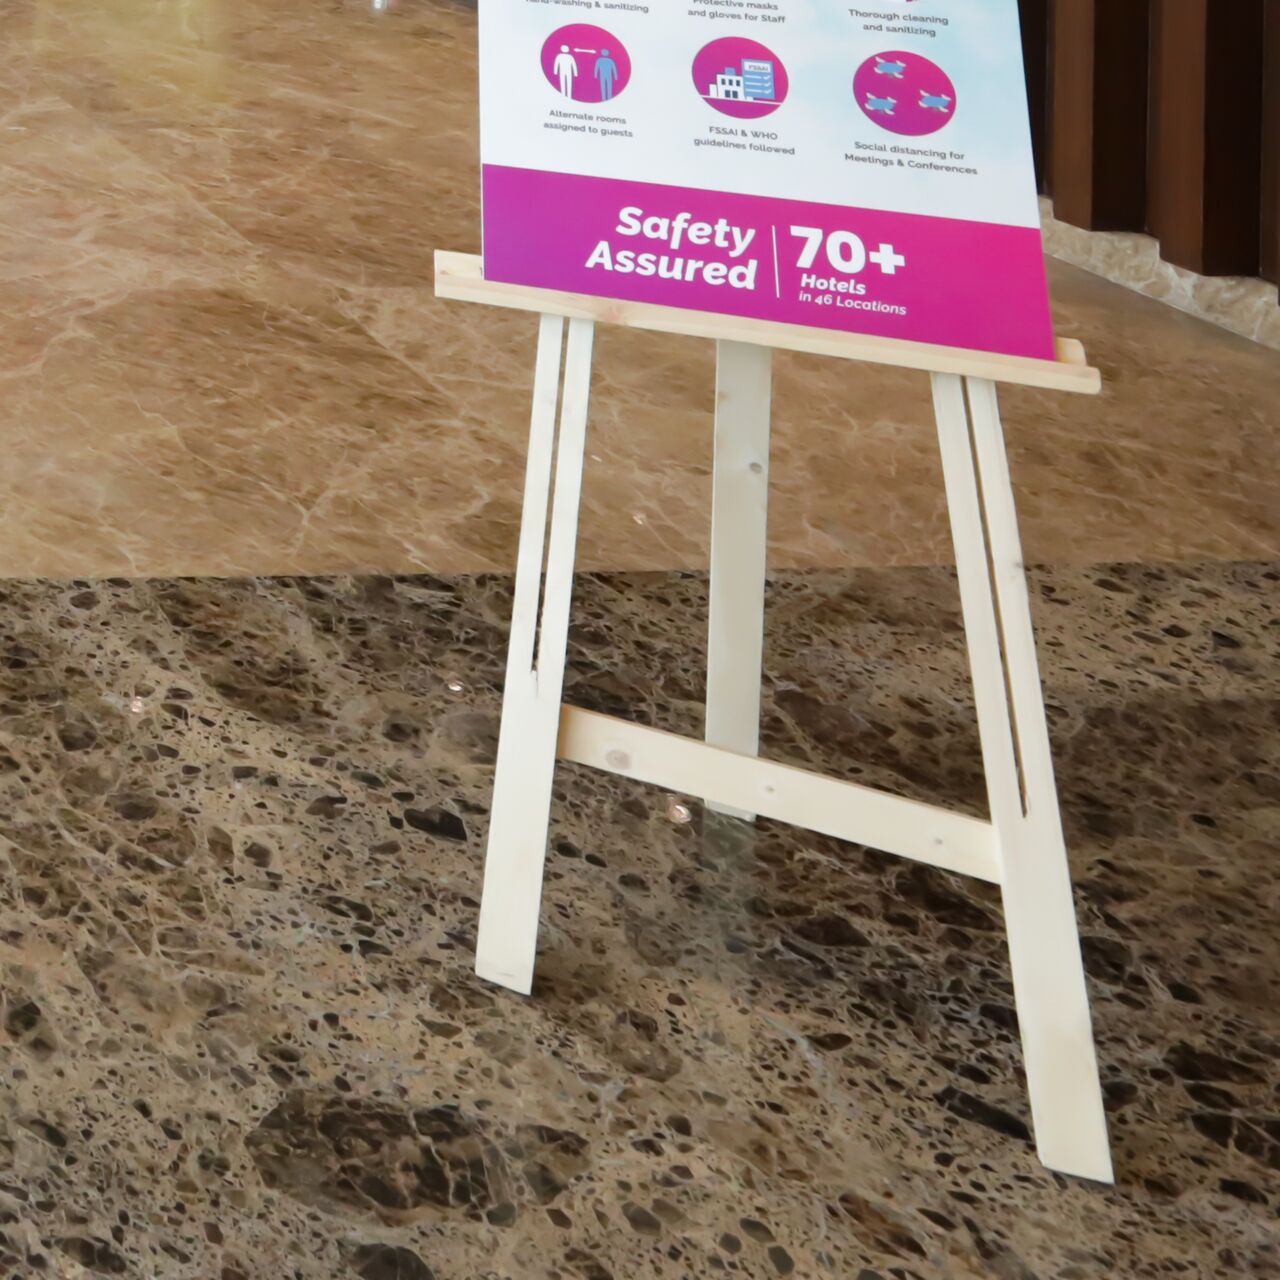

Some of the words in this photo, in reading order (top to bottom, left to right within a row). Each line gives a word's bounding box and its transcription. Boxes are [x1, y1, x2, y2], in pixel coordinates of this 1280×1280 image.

[604, 2, 649, 13] sanitizing
[746, 2, 778, 10] masks
[709, 10, 741, 19] gloves
[744, 12, 758, 20] for
[761, 14, 785, 22] Staff
[847, 9, 900, 21] Thorough
[902, 14, 949, 25] cleaning
[863, 23, 882, 31] and
[886, 25, 936, 37] sanitizing
[549, 109, 593, 120] Alternate
[596, 115, 626, 124] rooms
[544, 122, 586, 132] assigned
[600, 128, 632, 137] guests
[709, 126, 738, 135] FSSAI
[751, 131, 778, 140] WHO
[694, 138, 746, 149] guidelines
[749, 142, 795, 155] followed
[854, 141, 887, 152] Social
[889, 144, 947, 160] distancing
[949, 150, 964, 160] for
[844, 153, 893, 166] Meetings
[907, 160, 977, 174] Conferences
[614, 205, 757, 261] Safety
[789, 225, 907, 281] 70+
[584, 239, 758, 291] Assured
[799, 270, 866, 296] Hotels
[798, 289, 812, 302] in
[814, 292, 832, 305] 46
[836, 294, 906, 315] Locations
